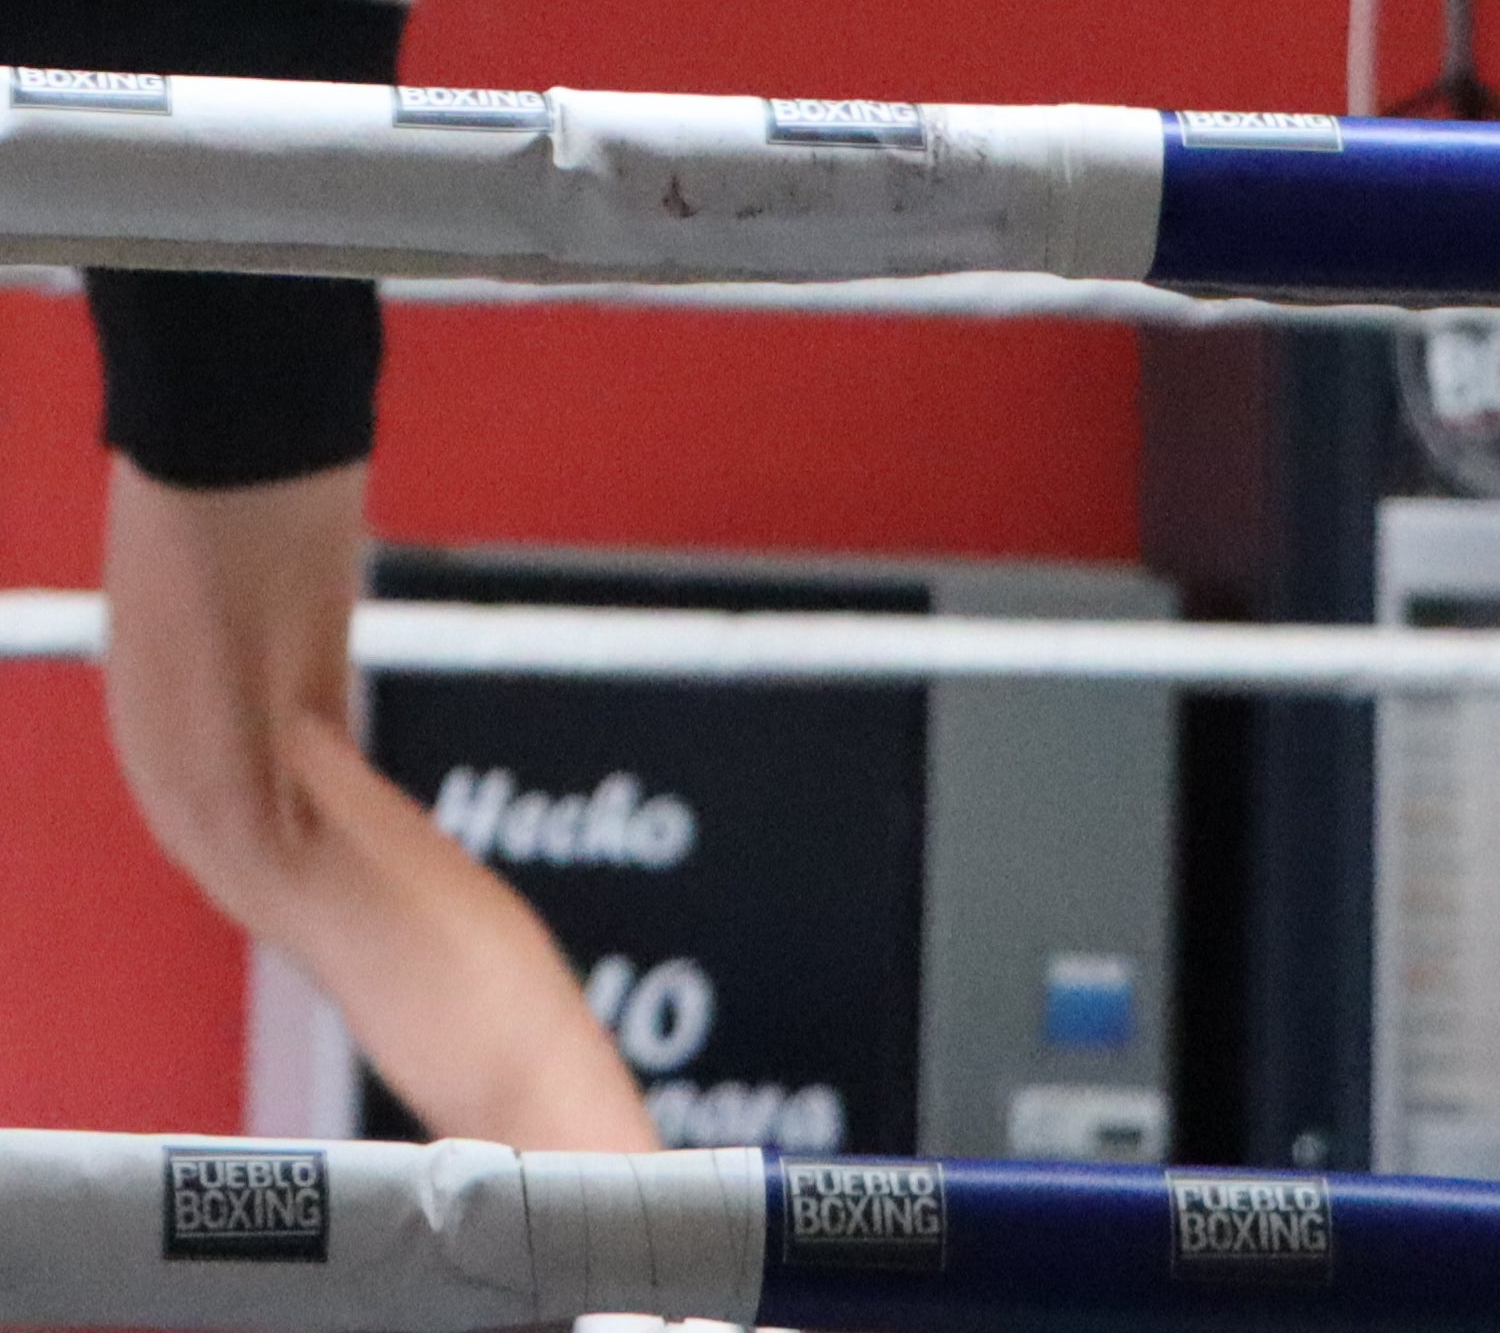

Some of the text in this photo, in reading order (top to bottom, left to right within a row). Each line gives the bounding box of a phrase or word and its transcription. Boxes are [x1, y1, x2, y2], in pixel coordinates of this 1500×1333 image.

[20, 68, 163, 90] BOXING
[403, 87, 547, 107] BOXING
[776, 100, 914, 123] BOXING
[1192, 112, 1330, 129] BOXING
[172, 1161, 317, 1189] PUEBLO
[790, 1169, 933, 1196] PUEBLO
[175, 1188, 321, 1230] BOXING
[1177, 1183, 1321, 1211] PUEBLO
[793, 1195, 939, 1234] BOXING
[1180, 1211, 1326, 1251] BOXING
